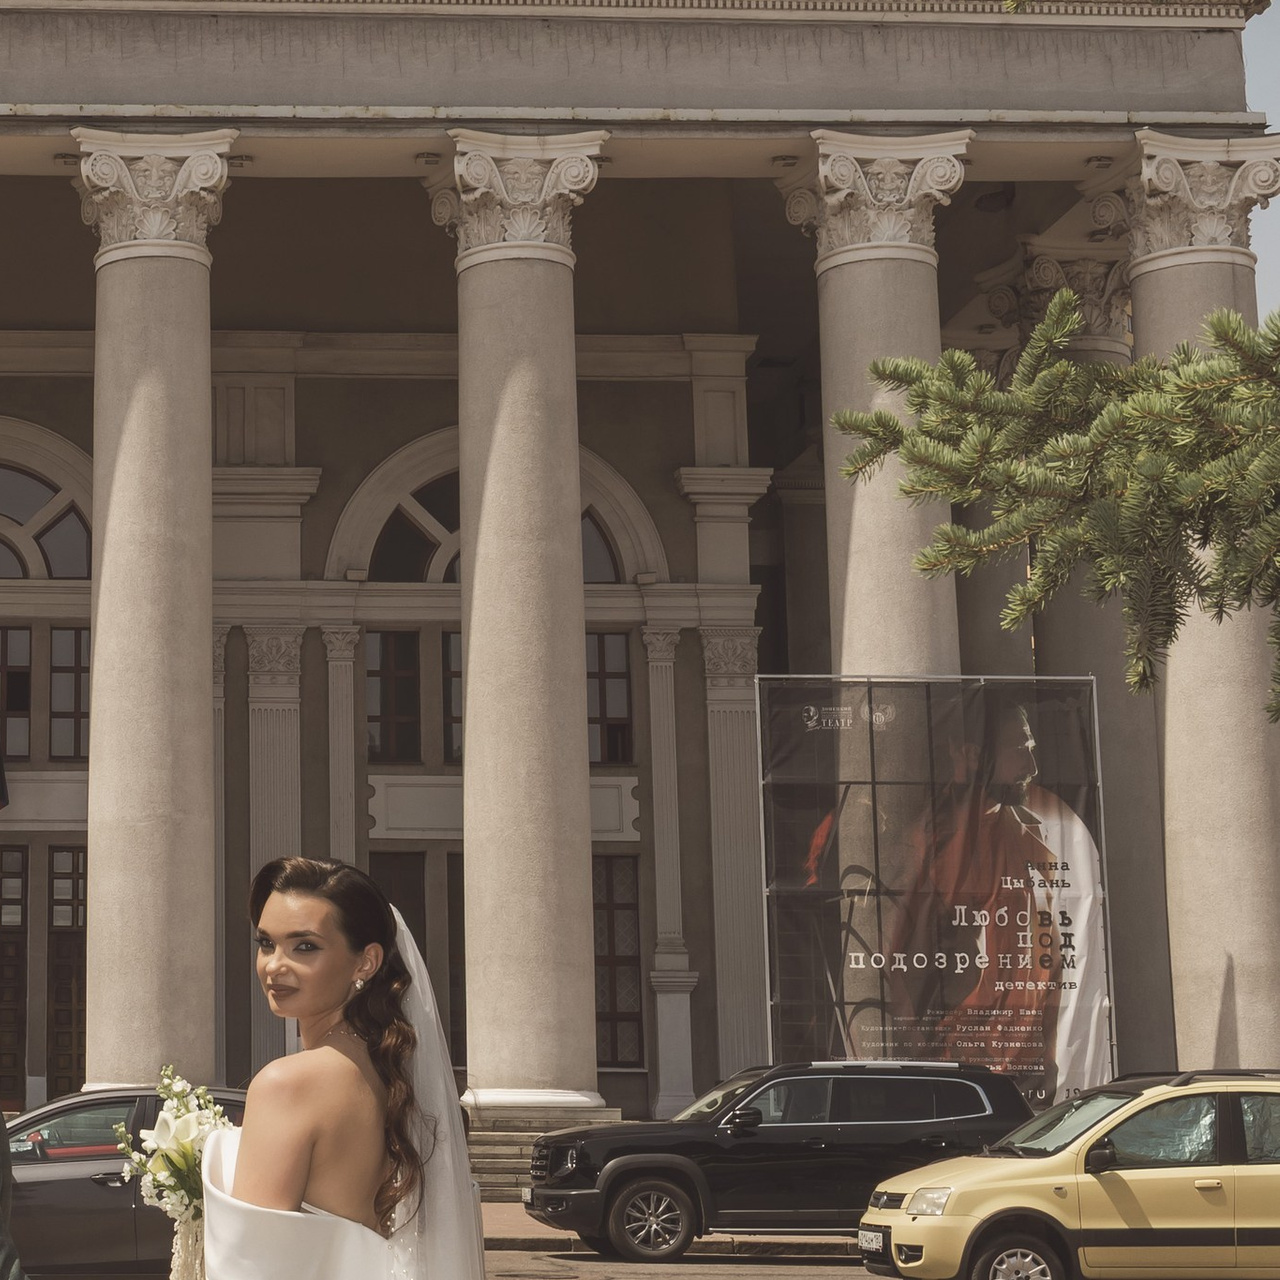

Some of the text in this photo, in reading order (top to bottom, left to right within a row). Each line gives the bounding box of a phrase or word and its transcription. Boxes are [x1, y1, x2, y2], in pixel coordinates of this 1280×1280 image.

[821, 718, 853, 727] ТЕАТР
[1024, 861, 1071, 872] Анна
[1001, 876, 1072, 890] Цыбань
[952, 904, 1073, 928] Любовь
[1017, 932, 1076, 951] под
[849, 952, 1077, 974] подозрением
[994, 981, 1078, 993] детектив
[967, 1008, 1014, 1017] Владимир
[1019, 1008, 1043, 1016] Швец
[956, 1024, 991, 1033] Руслан
[996, 1024, 1043, 1032] Фадиенко
[956, 1040, 986, 1048] Ольга
[991, 1040, 1044, 1049] Кузнецова
[1006, 1063, 1045, 1071] Волкова
